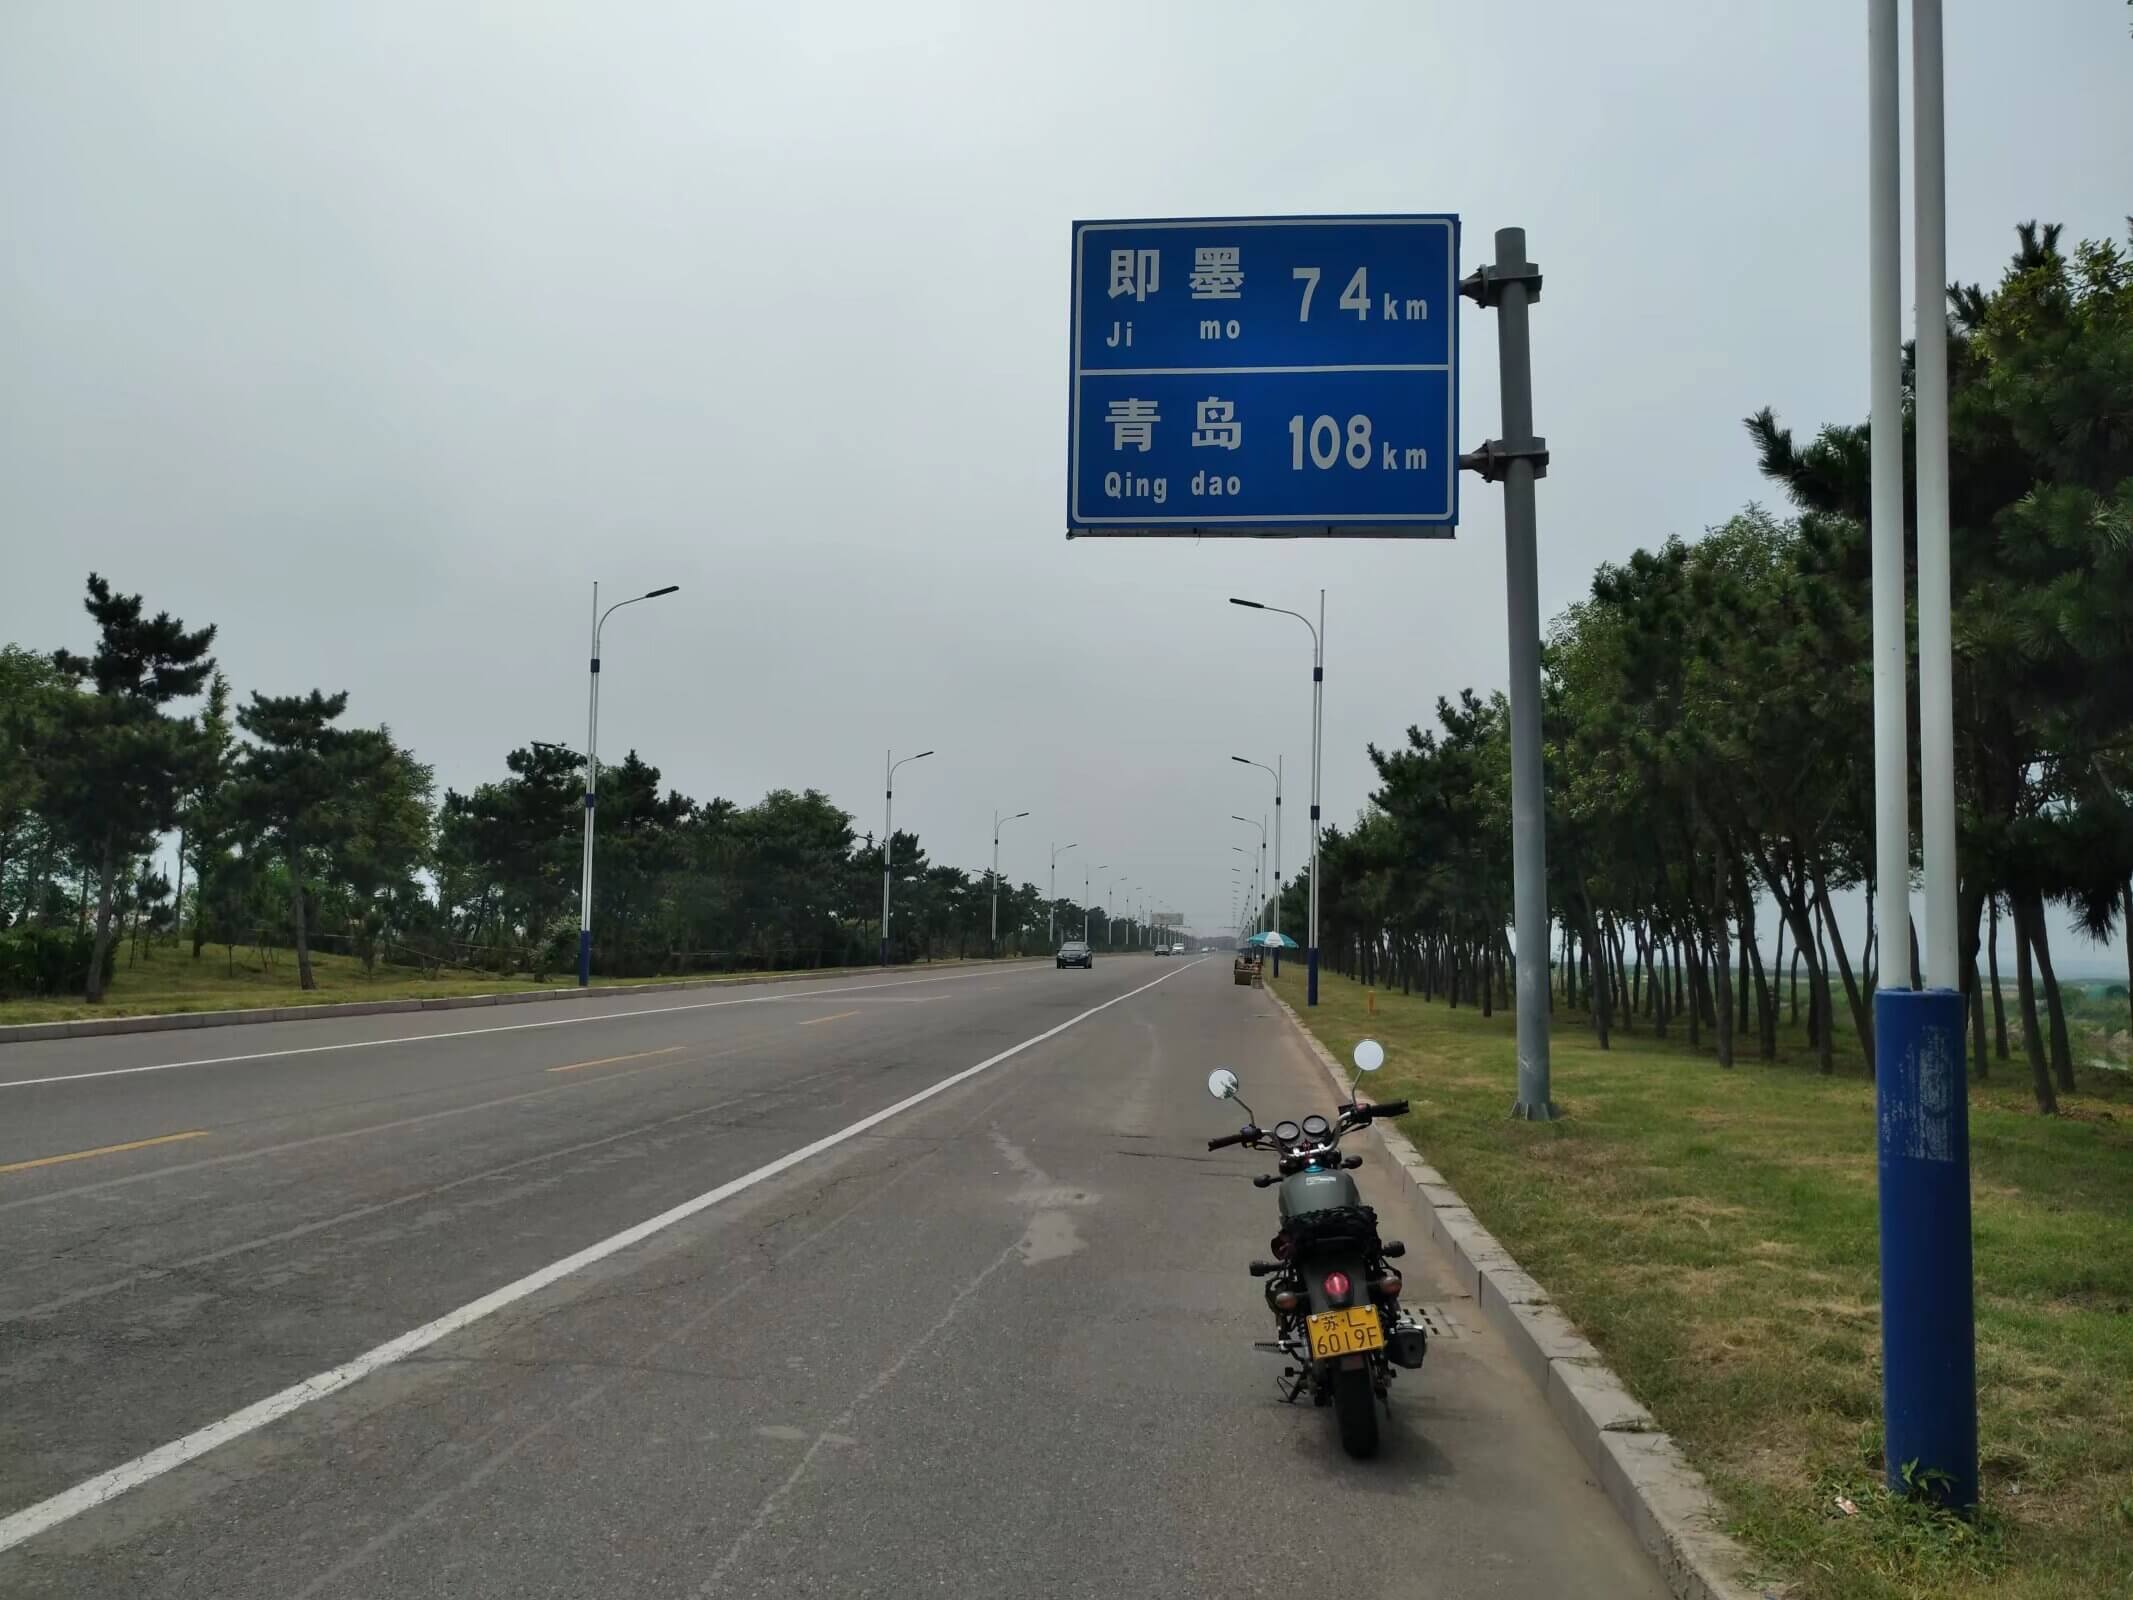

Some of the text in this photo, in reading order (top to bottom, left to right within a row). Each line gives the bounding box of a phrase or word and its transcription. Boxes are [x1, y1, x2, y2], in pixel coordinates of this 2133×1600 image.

[1107, 247, 1244, 301] 即墨
[1106, 319, 1241, 347] Ji mo
[1104, 396, 1242, 452] 青岛
[1104, 470, 1241, 503] Qing dao
[1317, 1326, 1377, 1355] 6019F
